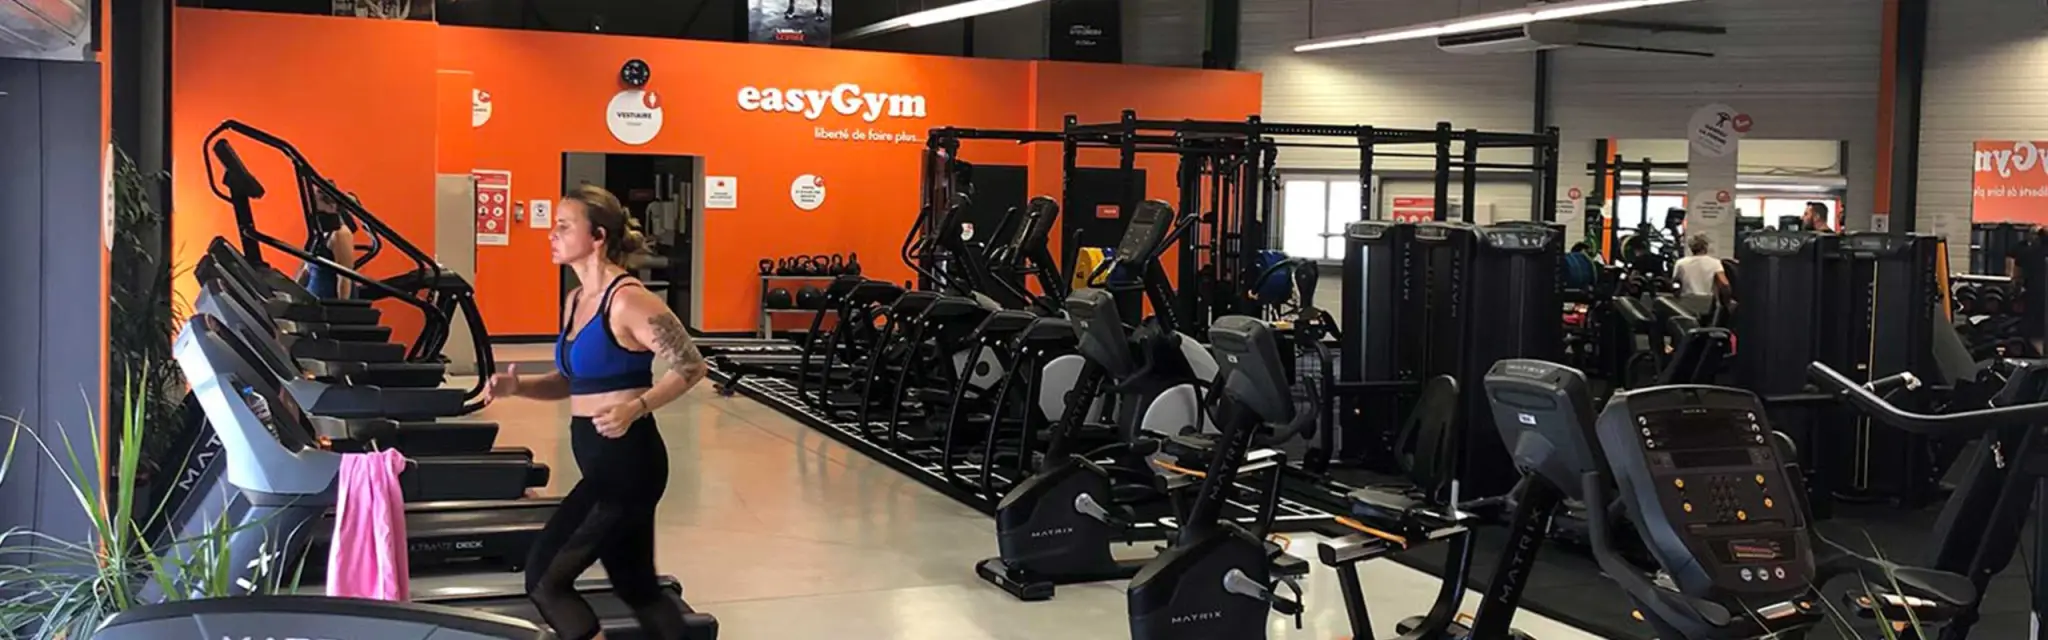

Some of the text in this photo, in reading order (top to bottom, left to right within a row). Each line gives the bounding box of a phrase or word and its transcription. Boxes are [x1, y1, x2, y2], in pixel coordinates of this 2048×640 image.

[738, 83, 926, 121] easyGym
[814, 126, 850, 140] liberté
[852, 130, 866, 140] de
[868, 128, 893, 142] faire
[1209, 428, 1244, 500] MATRIX
[1031, 527, 1073, 537] MATRIX
[455, 540, 484, 549] DECK
[1499, 507, 1541, 604] MATRIX
[1171, 610, 1223, 624] MATRIX
